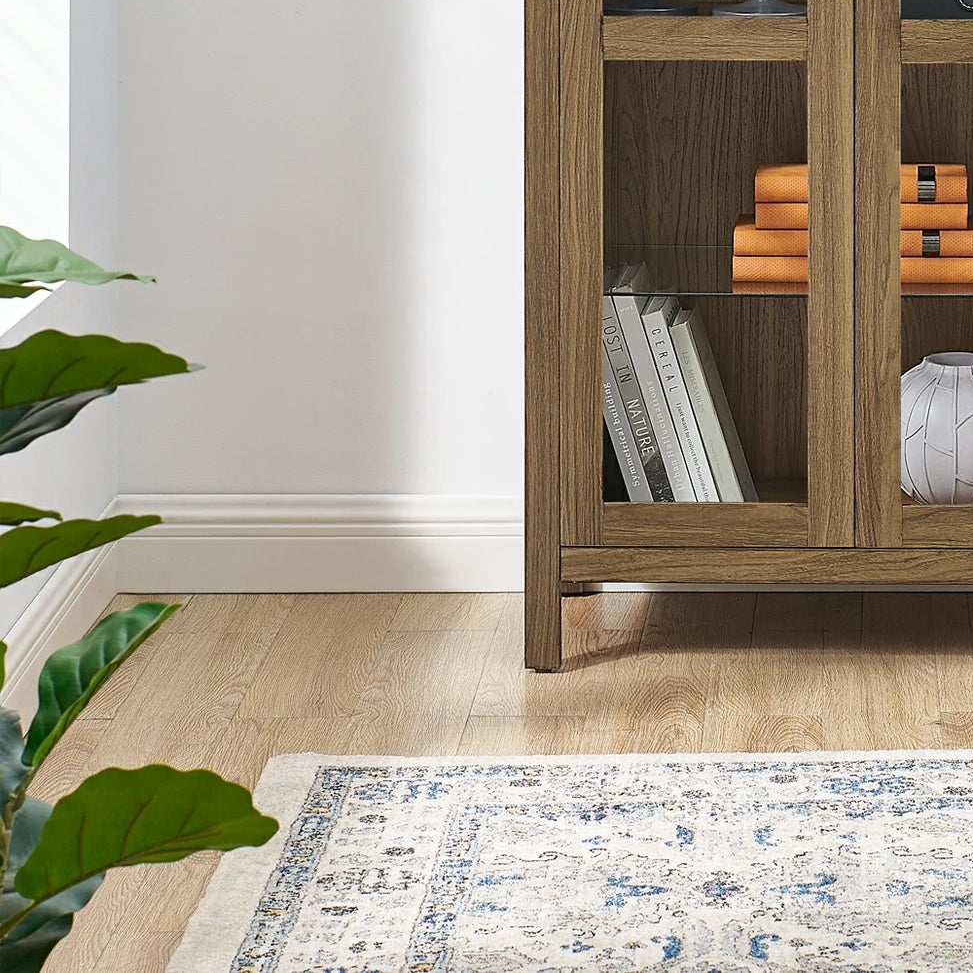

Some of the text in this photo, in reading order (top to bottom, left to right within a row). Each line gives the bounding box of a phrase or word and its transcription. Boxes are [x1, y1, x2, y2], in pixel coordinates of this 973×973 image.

[652, 328, 678, 392] CEREAL
[603, 382, 640, 486] Symmetrical building
[616, 365, 632, 383] IN
[626, 399, 655, 456] NATURE
[647, 381, 687, 492] Urban Hallucinations
